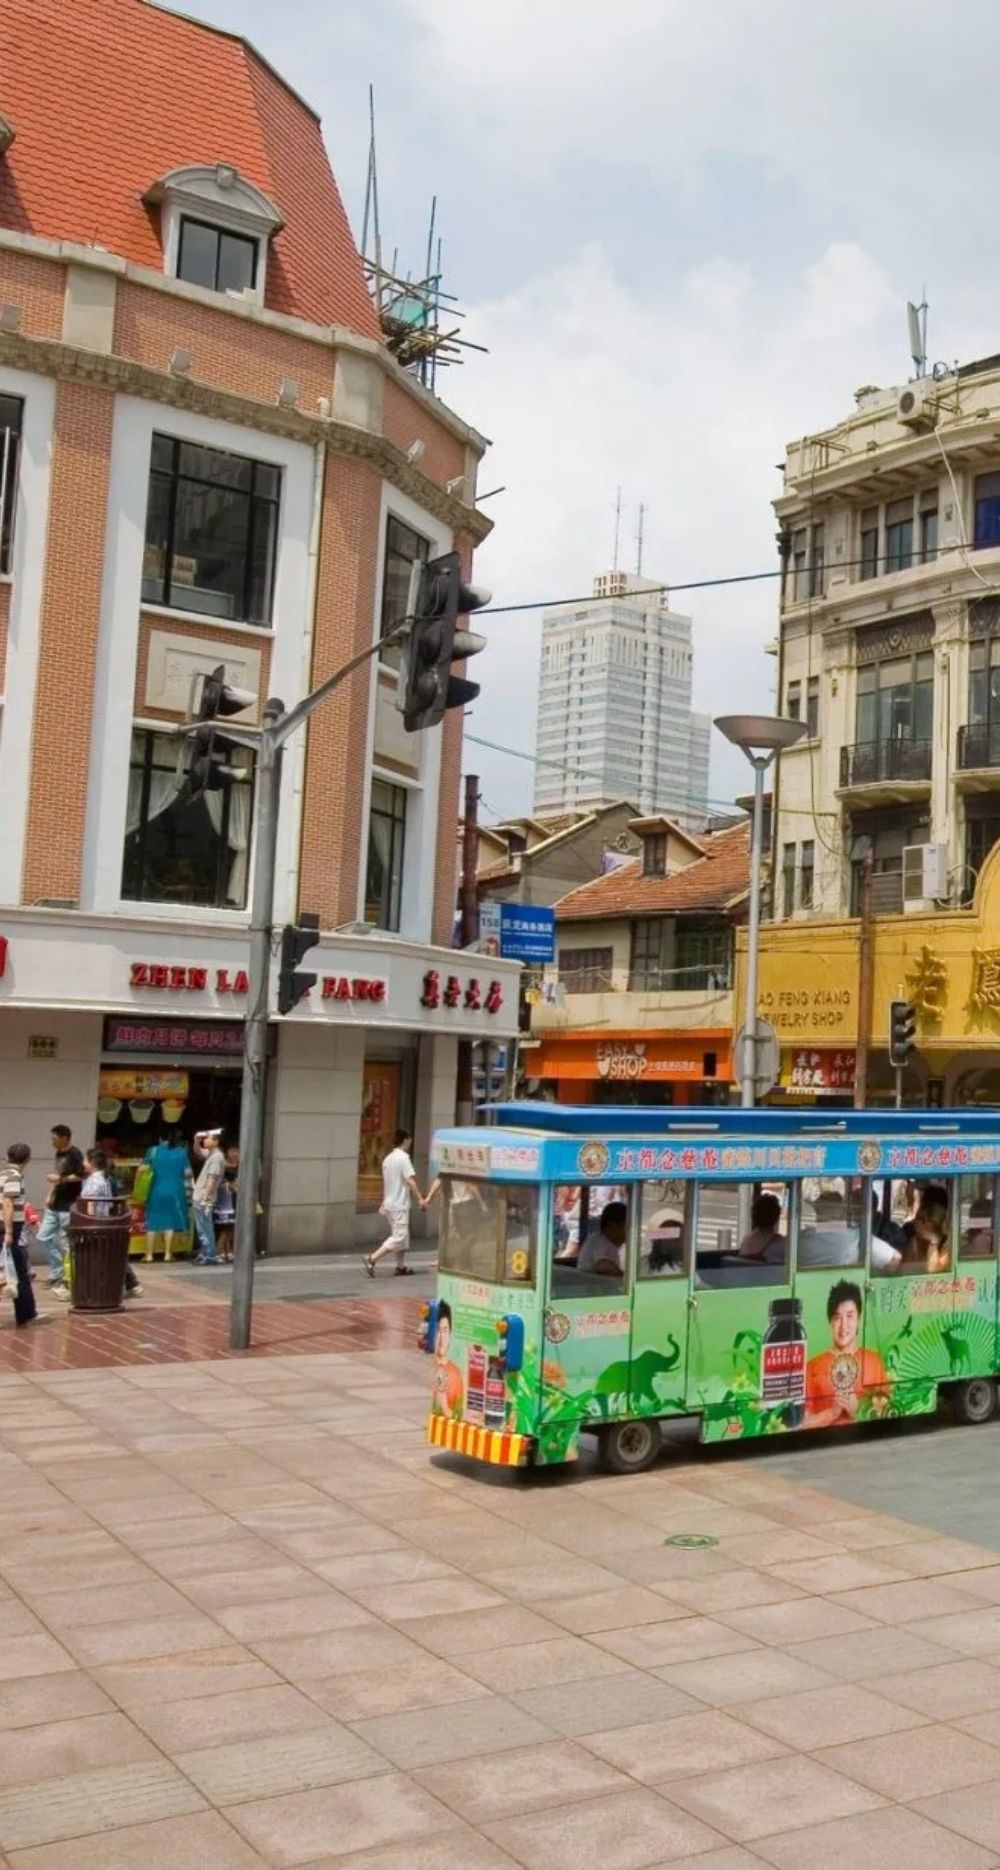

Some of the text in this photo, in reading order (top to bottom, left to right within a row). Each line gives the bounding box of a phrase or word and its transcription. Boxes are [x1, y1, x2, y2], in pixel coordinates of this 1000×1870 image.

[129, 963, 208, 991] ZHEN
[321, 976, 386, 1002] FANG
[779, 991, 808, 1006] FENG
[811, 1011, 844, 1026] SHOP
[610, 1057, 647, 1077] SHOP
[511, 1250, 528, 1275] 8
